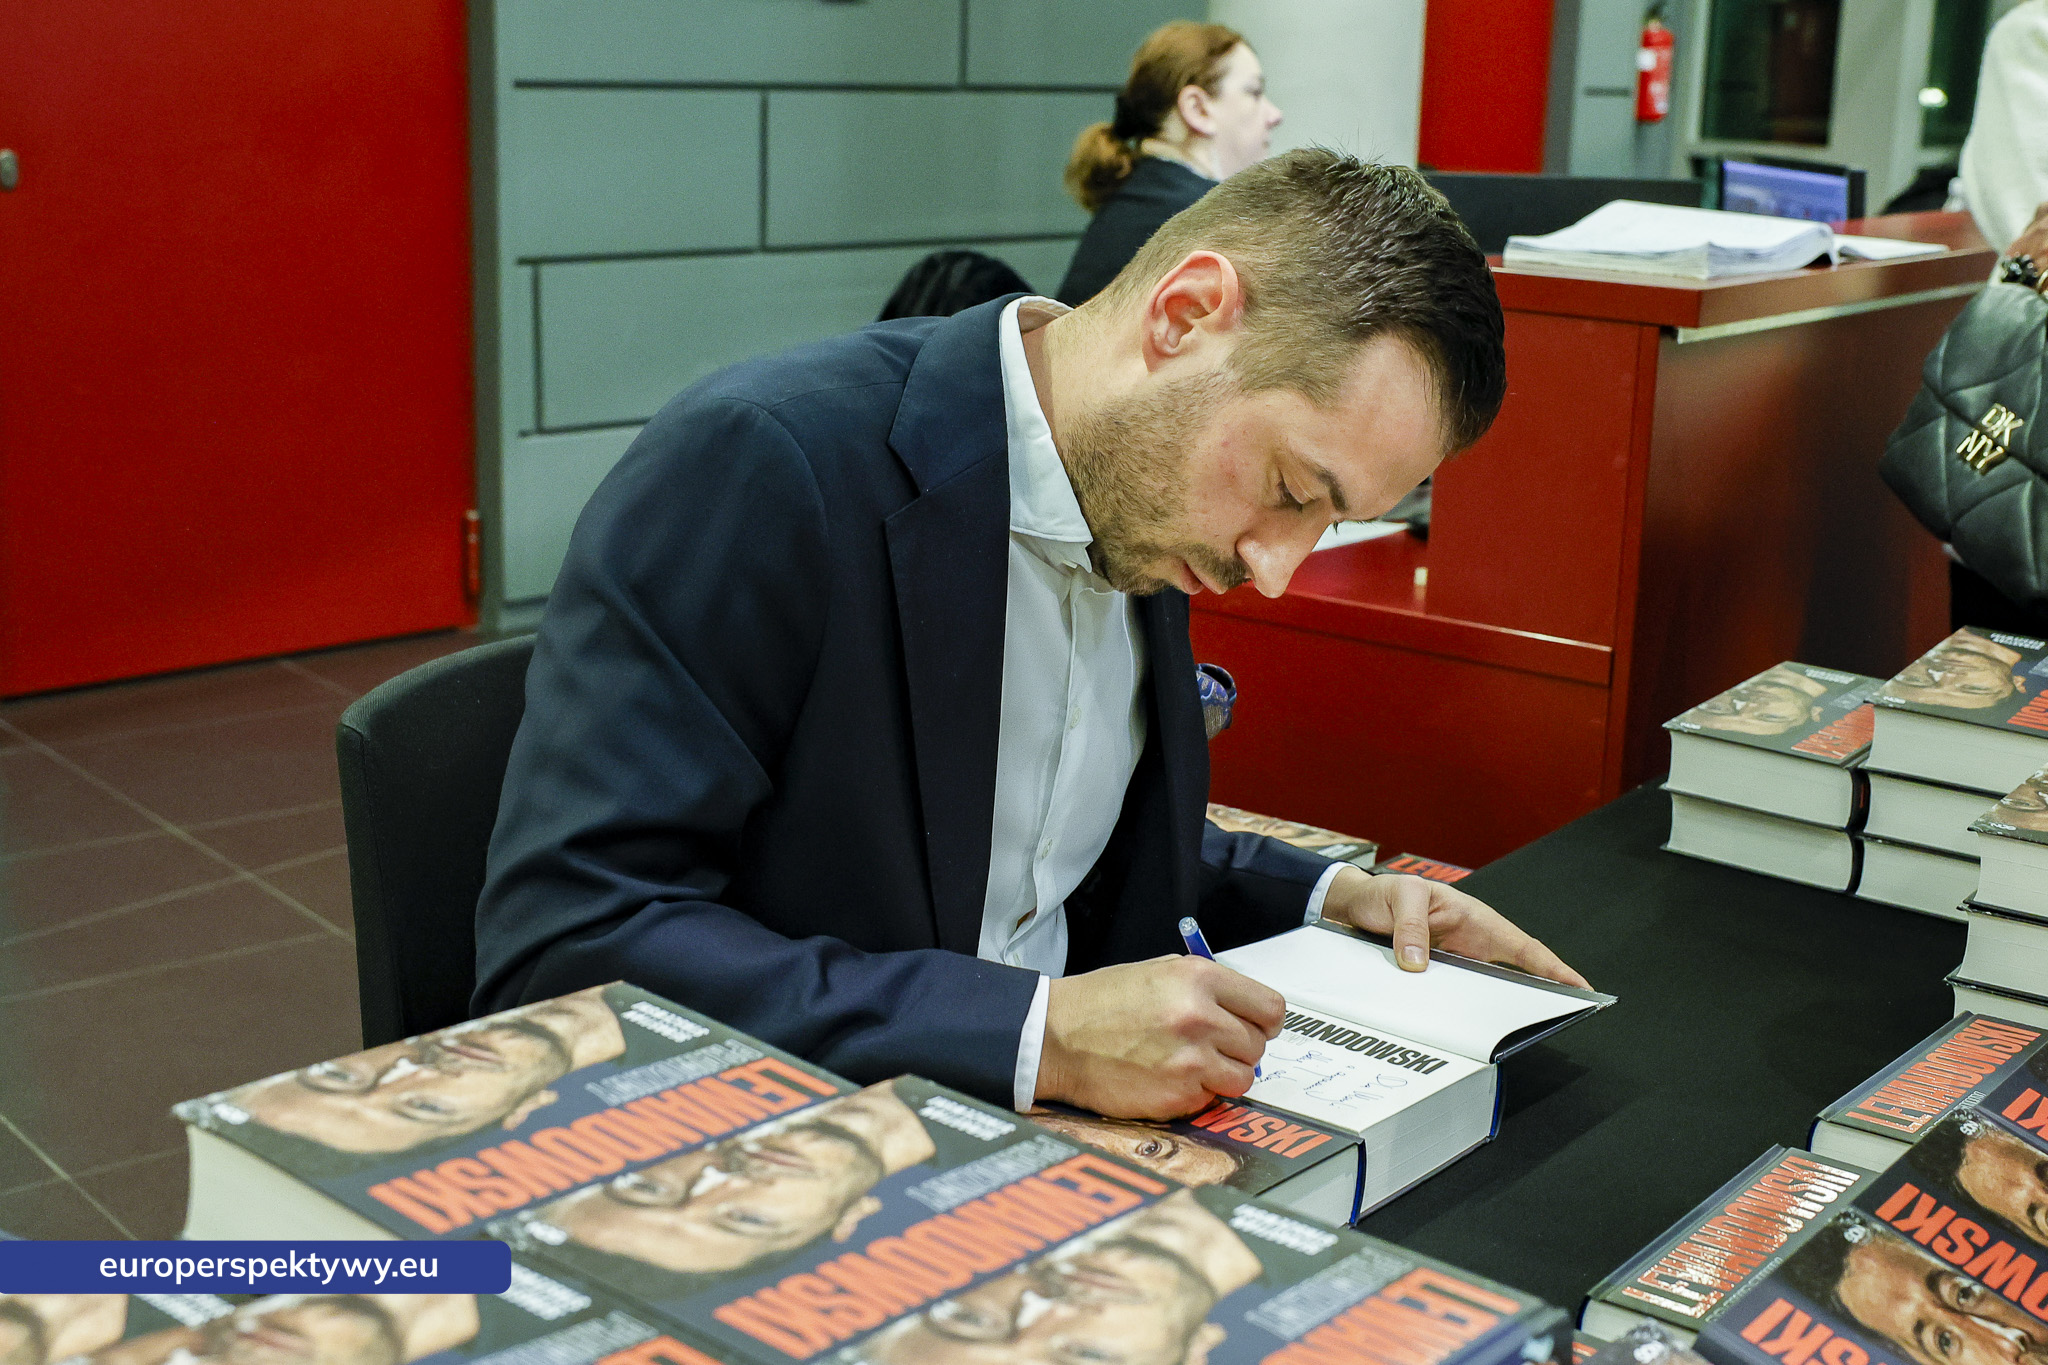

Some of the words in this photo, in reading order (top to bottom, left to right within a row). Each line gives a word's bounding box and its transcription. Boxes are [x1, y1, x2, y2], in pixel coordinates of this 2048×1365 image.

[1284, 1010, 1449, 1075] WANDOWSKI
[1845, 1018, 2041, 1134] LEWANDOWSKI
[369, 1057, 839, 1234] LEWANDOWSKI
[713, 1153, 1168, 1359] LEWANDOWSKI
[1621, 1156, 1861, 1319] LEWANDOWSKI
